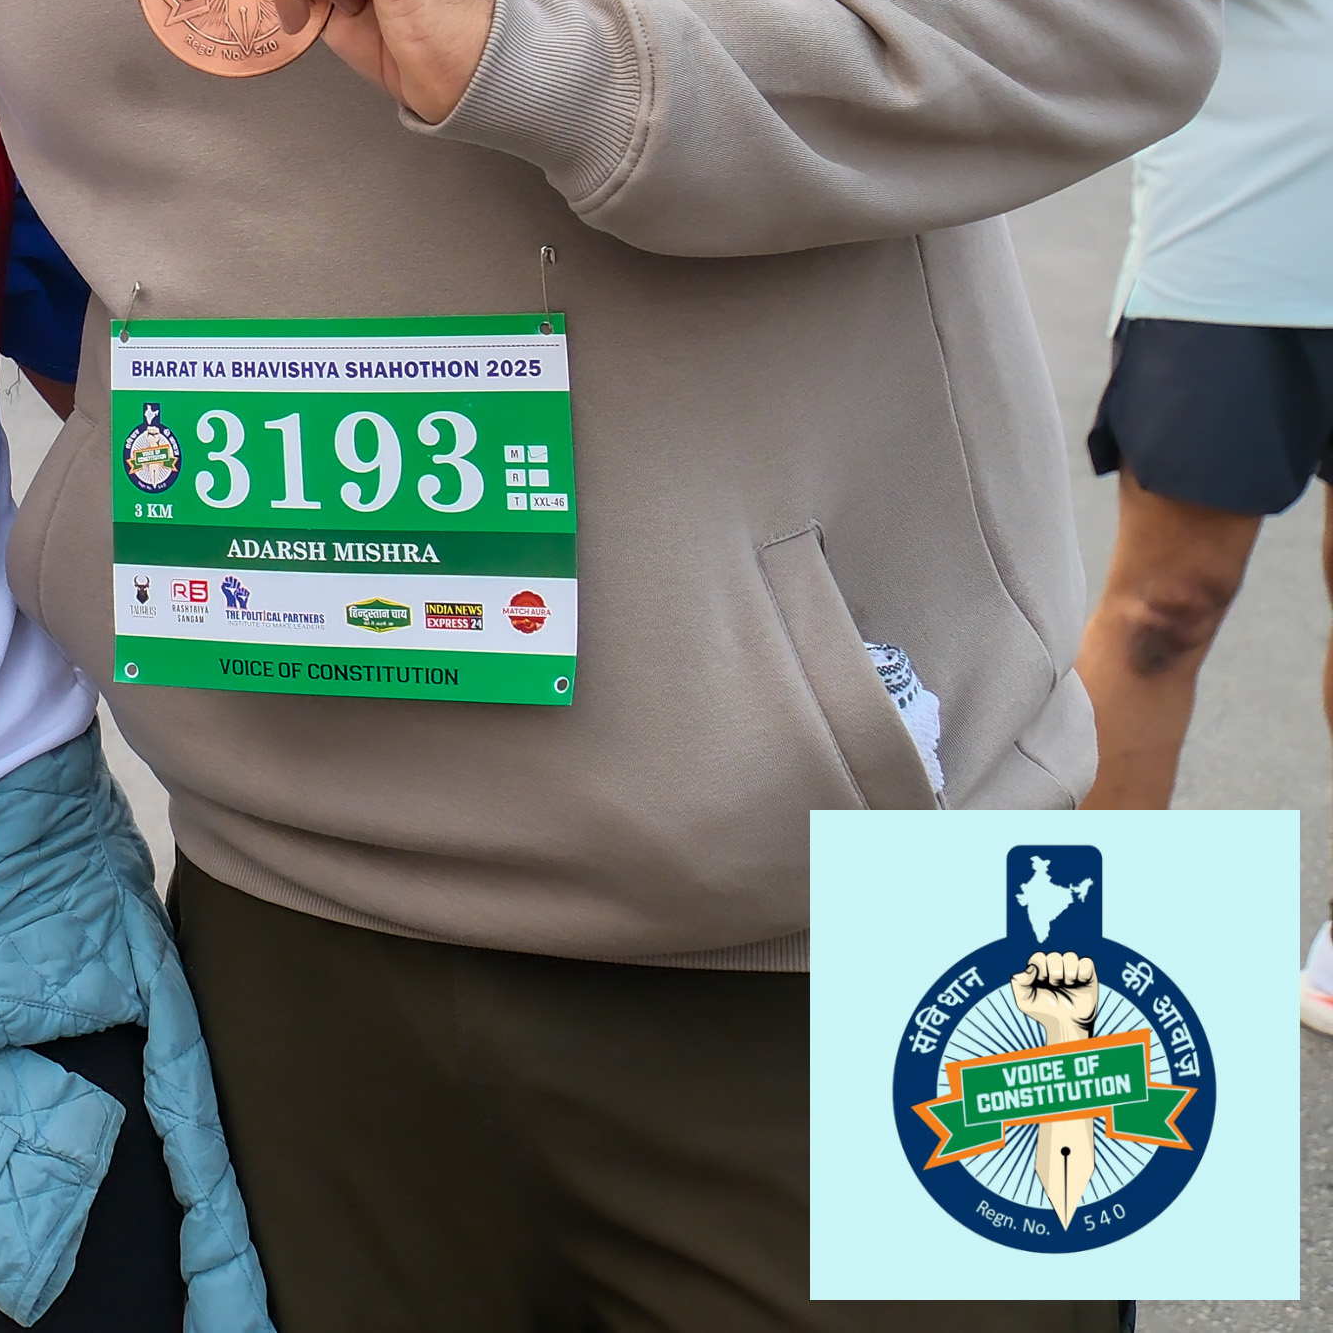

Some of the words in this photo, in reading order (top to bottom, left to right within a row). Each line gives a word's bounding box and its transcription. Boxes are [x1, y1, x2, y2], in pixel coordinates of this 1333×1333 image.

[254, 39, 278, 57] 540
[132, 361, 198, 378] BHARAT
[203, 361, 227, 378] KA
[232, 361, 341, 378] BHAVISHYA
[345, 359, 480, 378] SHAHOTHON
[486, 359, 542, 377] 2025
[195, 409, 485, 513] 3193
[510, 450, 518, 458] M
[534, 497, 565, 507] XXL-46
[134, 503, 143, 518] 3
[146, 503, 173, 519] KM
[227, 538, 326, 561] ADARSH
[332, 541, 440, 565] MISHRA
[172, 604, 209, 614] RASHTRIYA
[426, 604, 454, 614] INDIA
[455, 605, 483, 616] NEWS
[177, 614, 205, 623] SANGAM
[226, 610, 240, 620] THE
[241, 610, 281, 622] POLITICAL
[283, 613, 325, 624] PARTNERS
[427, 619, 469, 629] EXPRESS
[470, 619, 482, 629] 24
[219, 659, 274, 678] VOICE
[278, 662, 303, 679] OF
[308, 664, 459, 686] CONSTITUTION
